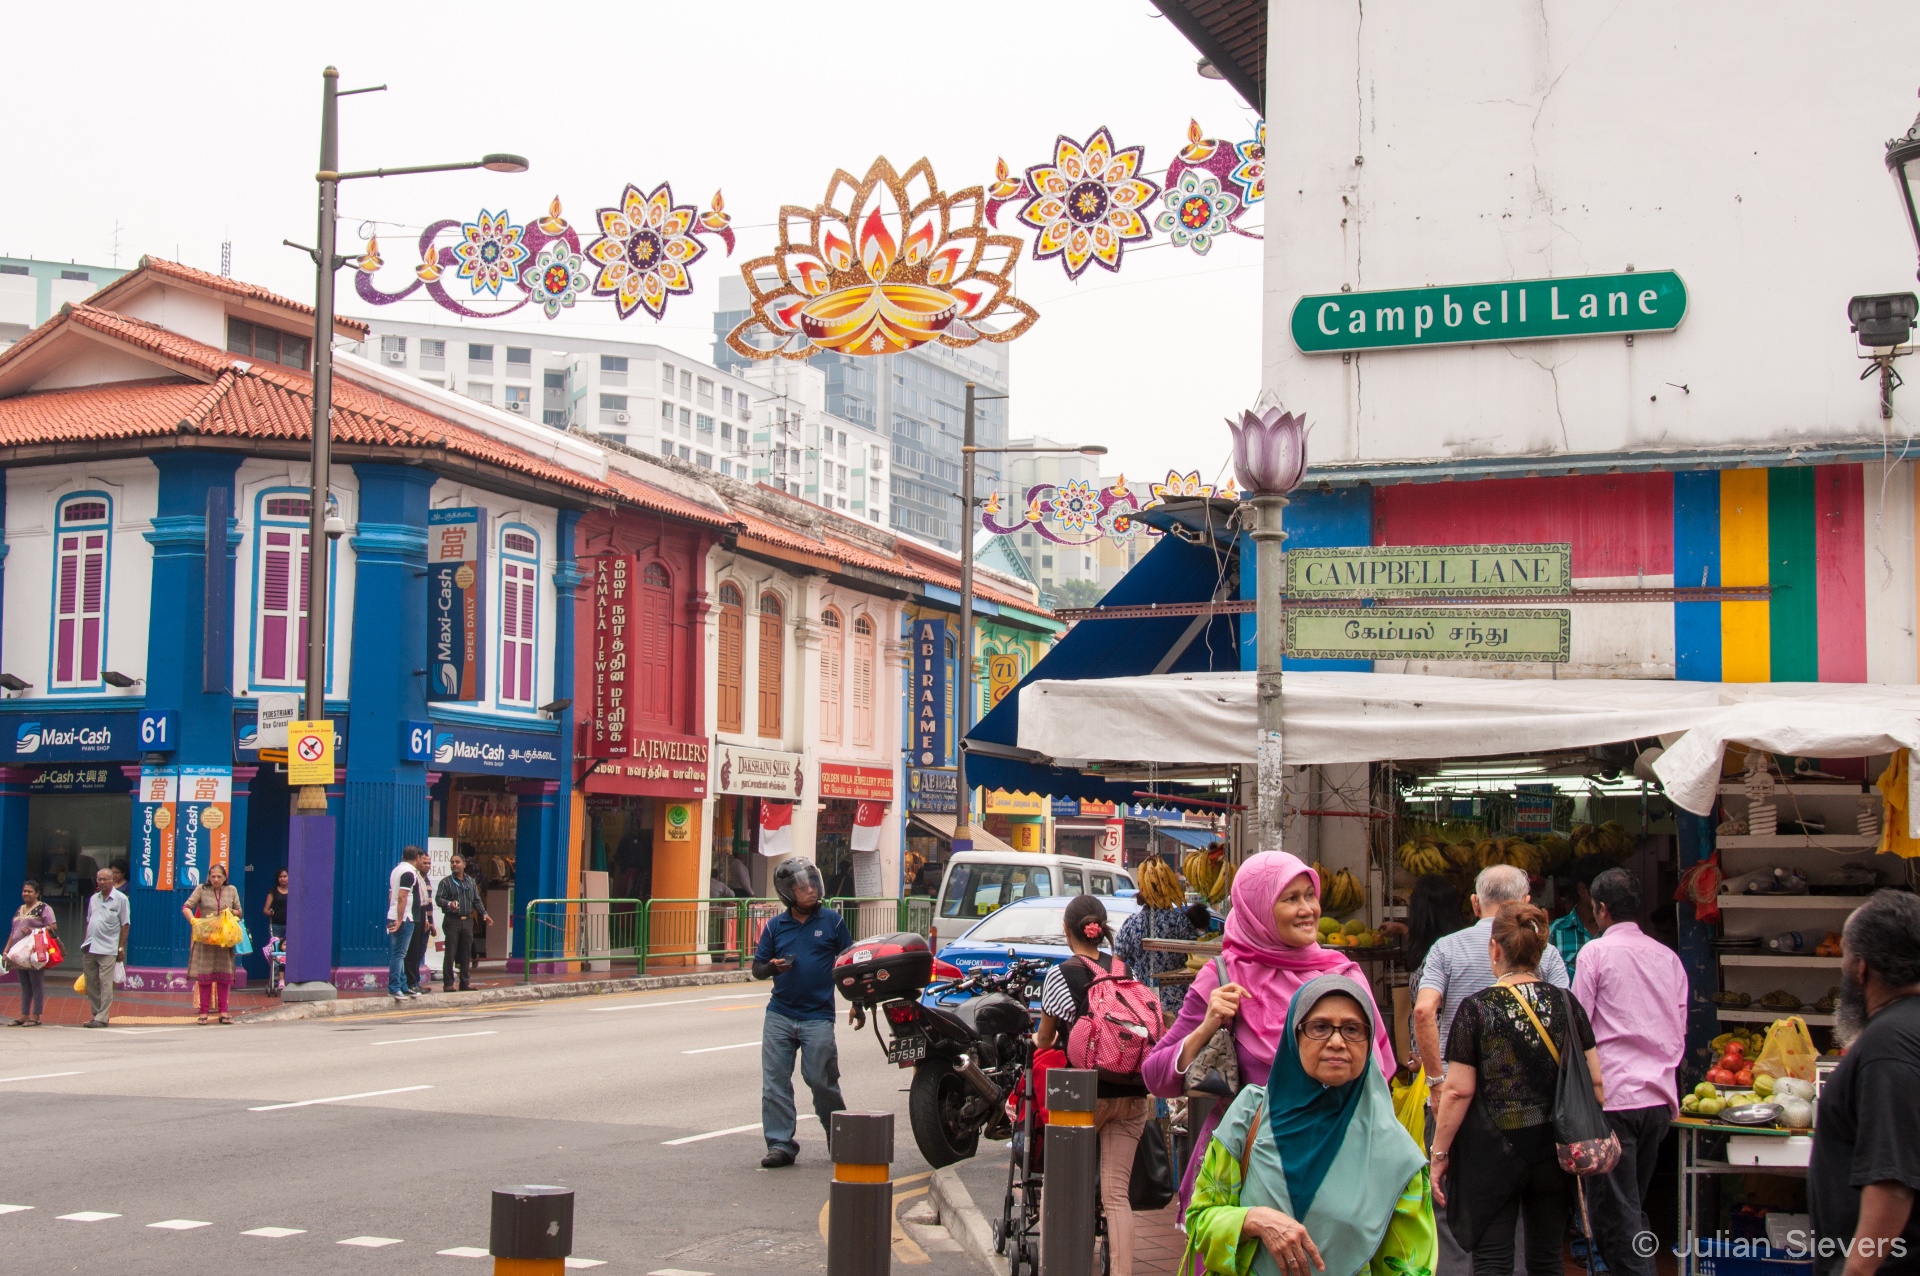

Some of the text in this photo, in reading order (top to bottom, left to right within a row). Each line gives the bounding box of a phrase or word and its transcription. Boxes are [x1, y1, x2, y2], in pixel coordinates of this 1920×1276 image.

[1317, 287, 1658, 337] Campbell Lane
[440, 526, 467, 559] 當
[1305, 559, 1550, 585] CAMPBELL LANE
[438, 569, 452, 661] Maxi-Cash
[467, 597, 475, 627] DAILY
[1345, 620, 1508, 648] கேம்பல் சந்து
[595, 560, 608, 741] KAMALA JEWELLERS
[995, 664, 1011, 677] 71
[920, 623, 936, 748] ABIRAAME
[262, 708, 293, 718] PEDESTRIANS
[273, 720, 288, 728] Crossi
[41, 726, 111, 746] Maxi-Cash
[141, 717, 166, 743] 61
[411, 728, 432, 754] 61
[454, 740, 505, 760] Maxi-Cash
[648, 740, 707, 763] JEWELLERS
[76, 770, 108, 783] 大興當
[738, 756, 790, 777] DAKSHAINI SILKS
[150, 777, 168, 801] 當
[195, 777, 219, 800] 當
[822, 772, 840, 783] GOLDEN
[840, 774, 853, 784] VILLA
[853, 775, 877, 786] JEWELLERY
[877, 776, 885, 786] PTE
[921, 771, 958, 792] ABIRAA
[142, 806, 153, 866] Maxi-Cash
[185, 805, 198, 866] Maxi-Cash
[219, 833, 227, 858] DAILY
[1102, 832, 1118, 846] 75
[889, 1047, 924, 1063] 8759 R
[900, 1038, 914, 1050] FT
